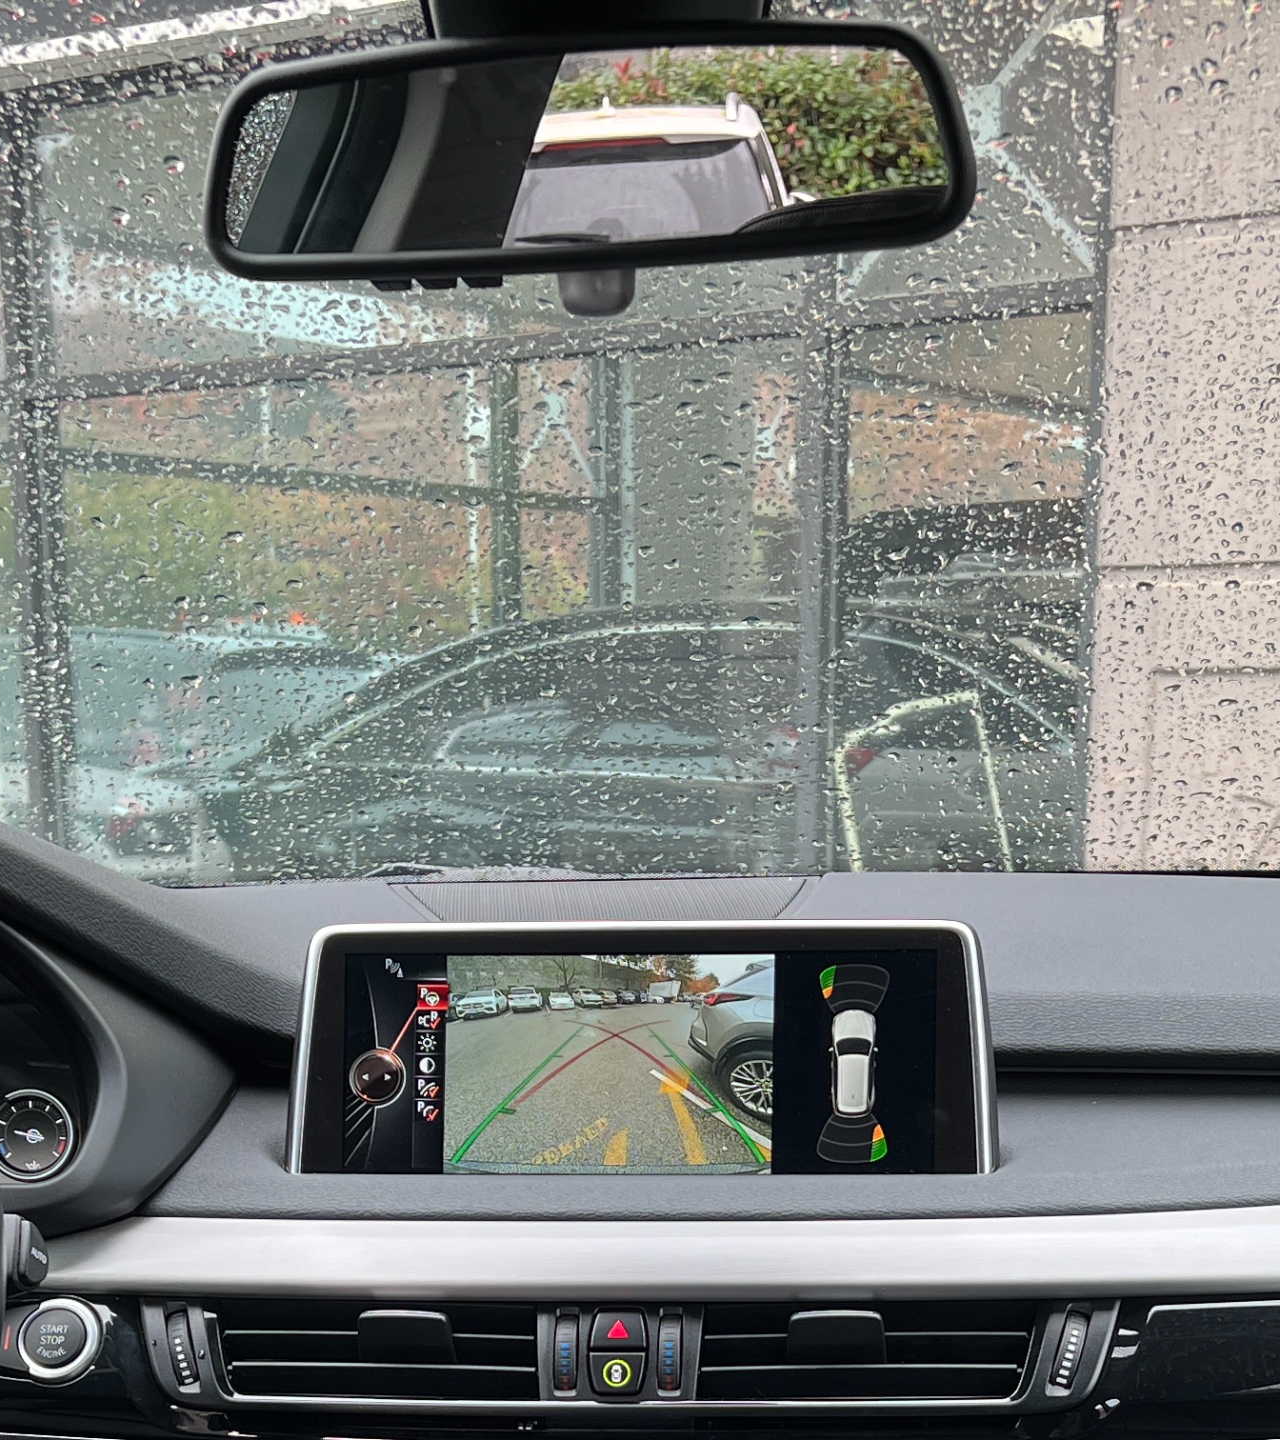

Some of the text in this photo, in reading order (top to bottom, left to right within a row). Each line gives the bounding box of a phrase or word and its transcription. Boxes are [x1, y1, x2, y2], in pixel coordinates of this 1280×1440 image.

[30, 1246, 48, 1265] AUTO
[40, 1324, 69, 1334] START
[40, 1335, 65, 1345] STOP
[36, 1346, 67, 1359] ENGINE
